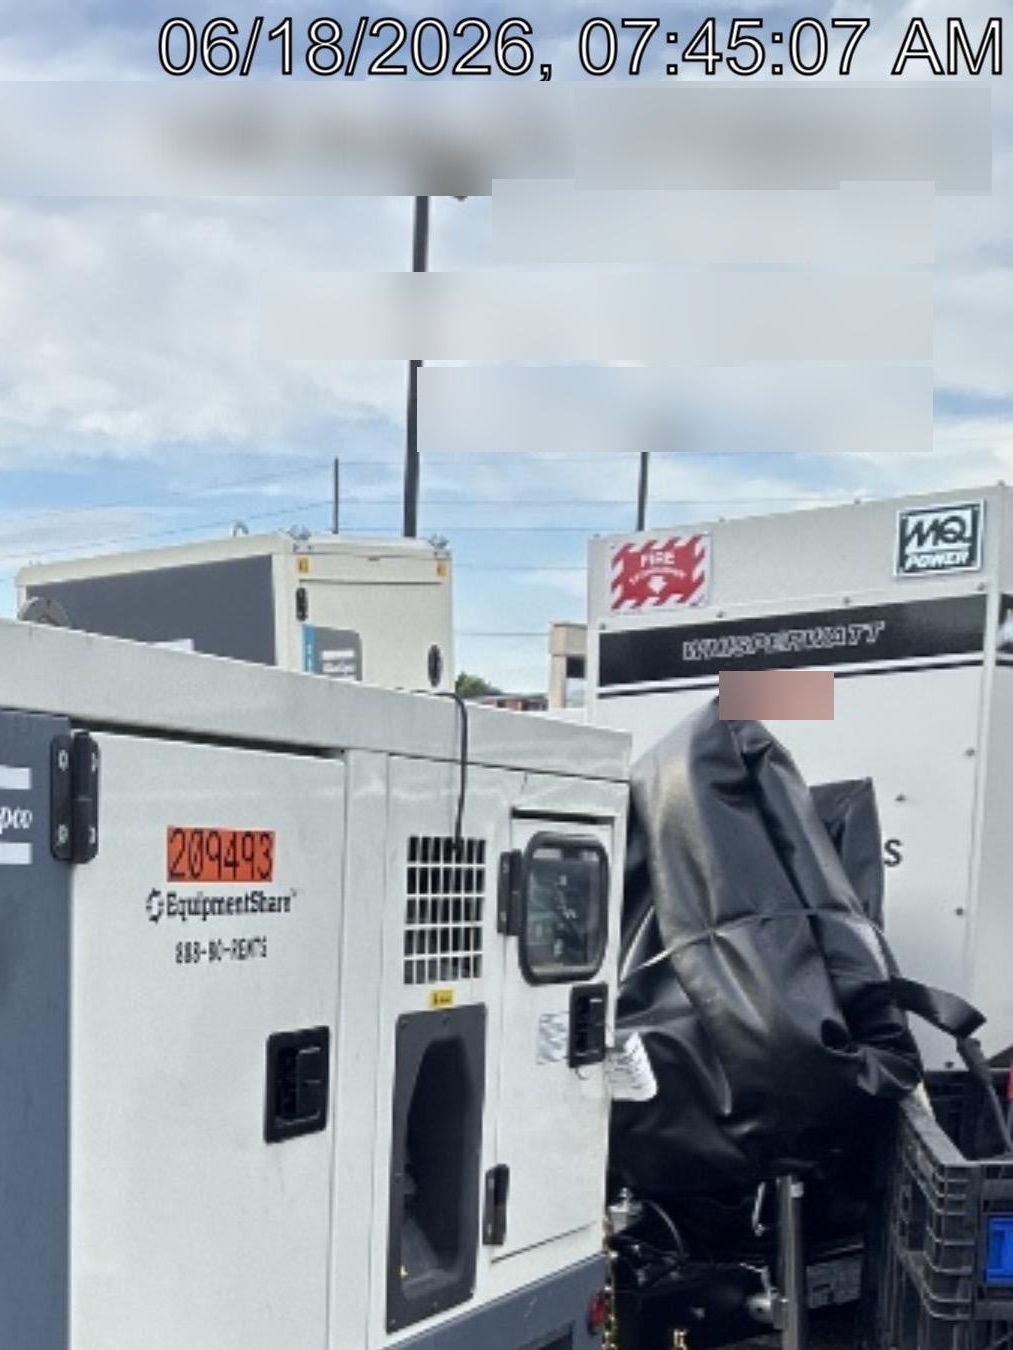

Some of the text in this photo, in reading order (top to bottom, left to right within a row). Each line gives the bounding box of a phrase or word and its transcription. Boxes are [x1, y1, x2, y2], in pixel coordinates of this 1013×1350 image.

[640, 550, 676, 569] FIRE
[905, 551, 969, 570] POWER
[682, 620, 886, 661] WHISPERWATT
[168, 827, 273, 881] 209493
[166, 890, 291, 922] EquipmentShare
